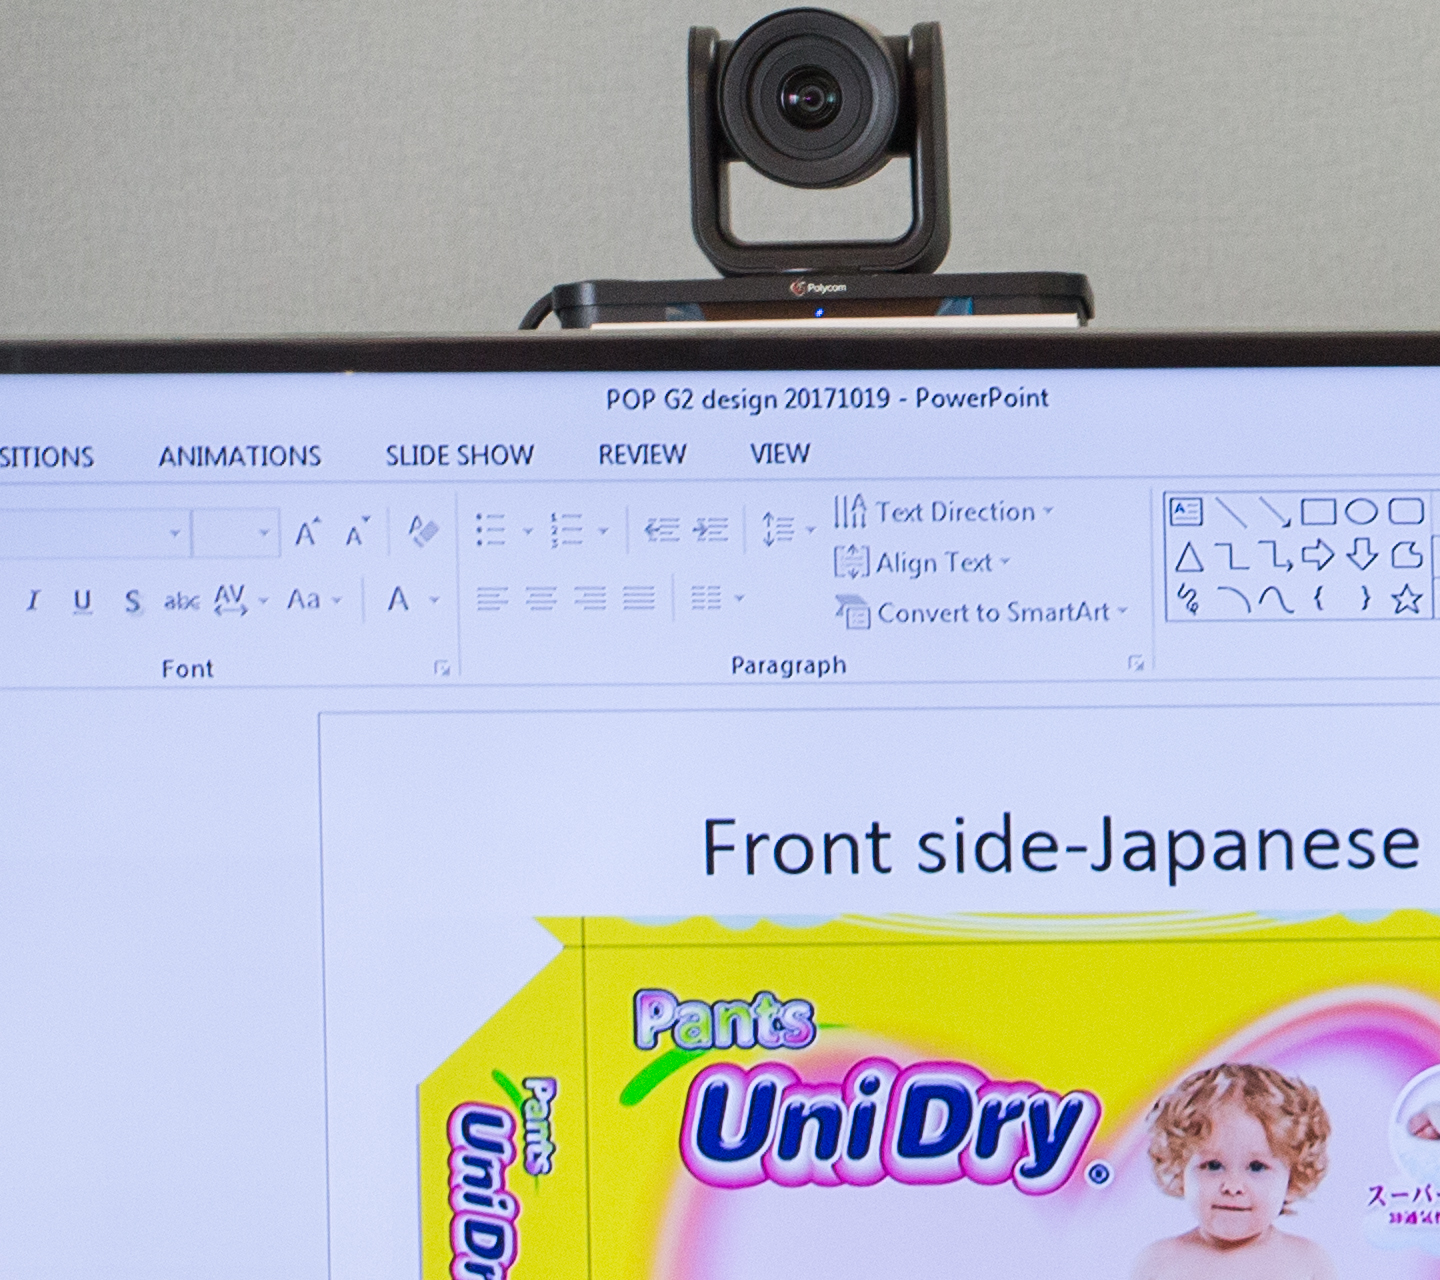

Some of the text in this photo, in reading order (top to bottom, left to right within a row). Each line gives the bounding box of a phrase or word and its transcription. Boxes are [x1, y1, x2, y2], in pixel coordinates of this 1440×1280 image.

[806, 282, 847, 295] Polycom
[606, 388, 656, 411] POP
[663, 387, 694, 410] G2
[701, 387, 778, 416] design
[784, 386, 891, 410] 20171019
[916, 386, 1049, 409] PowerPoint
[0, 445, 95, 469] SITIONS
[158, 444, 322, 468] ANIMATIONS
[386, 443, 535, 467] SLIDE SHOW
[599, 443, 687, 466] REVIEW
[750, 442, 811, 465] VIEW
[876, 500, 1036, 523] Text Direction
[875, 551, 992, 580] Align Text
[877, 600, 1110, 623] Convert to SmartArt
[162, 659, 214, 679] Font
[731, 655, 848, 682] Paragraph
[705, 811, 1420, 887] Front side-Japanese
[634, 988, 817, 1050] Pants
[522, 1077, 558, 1176] Pants
